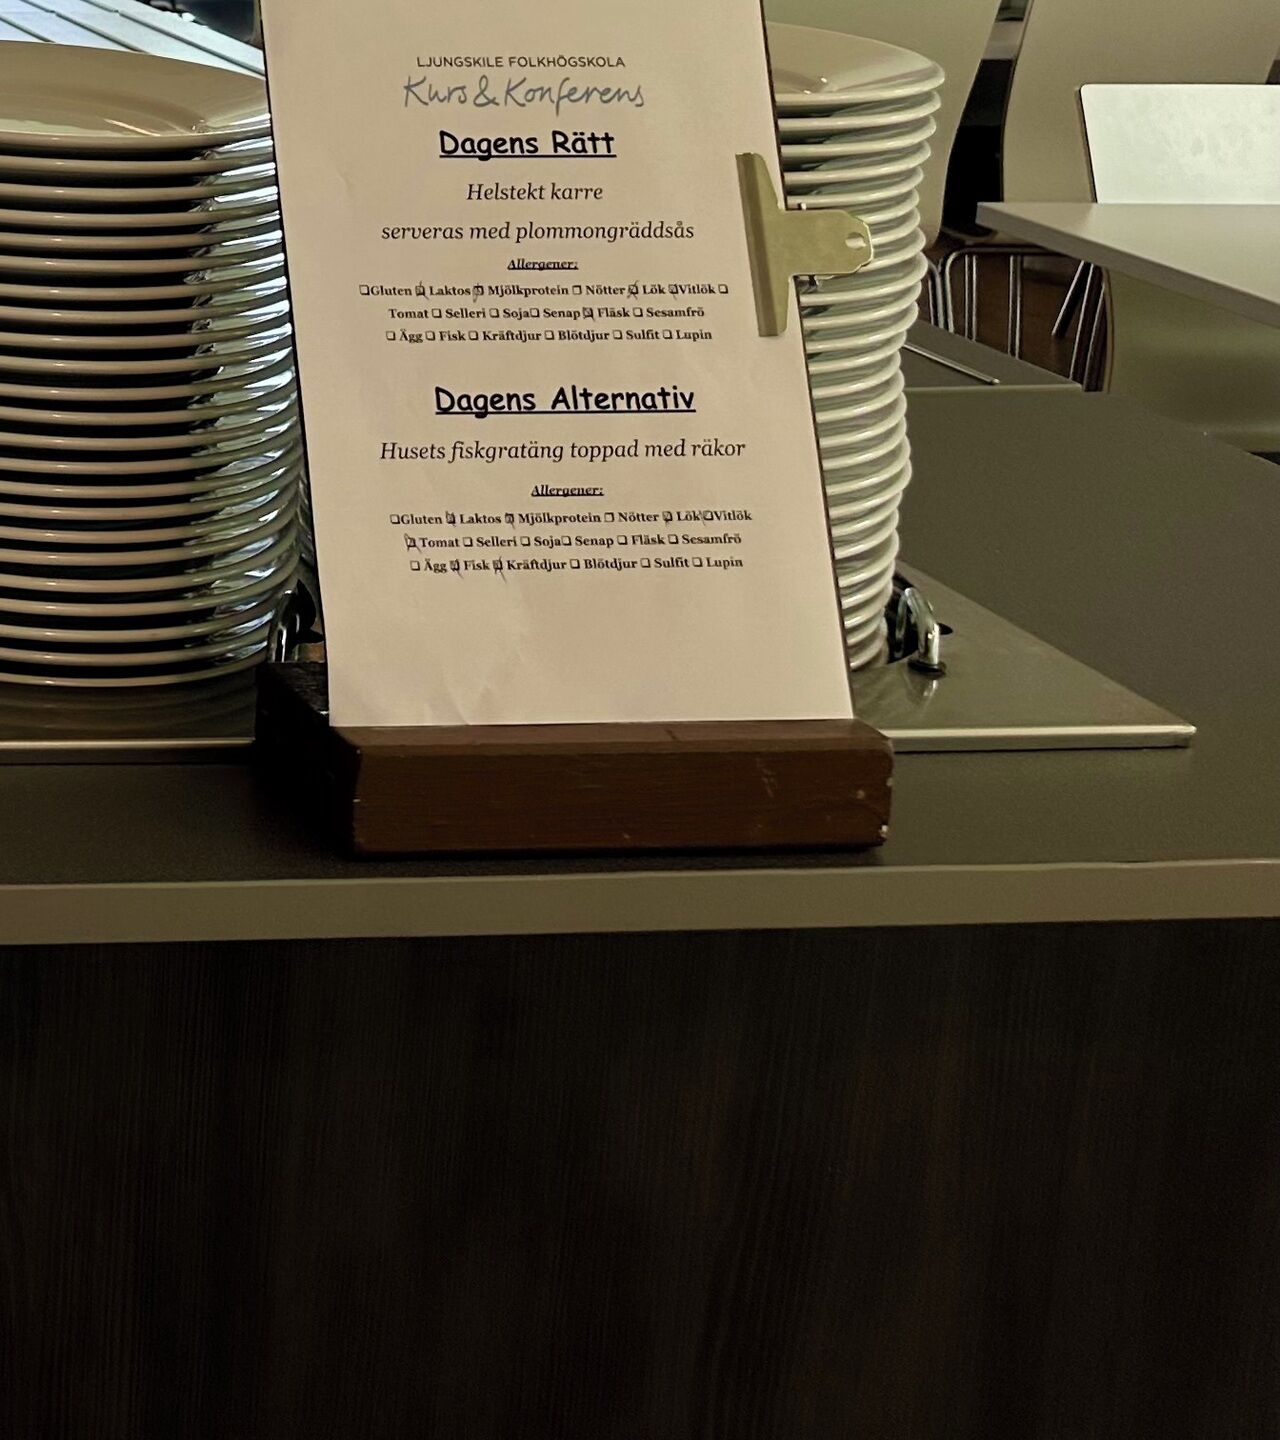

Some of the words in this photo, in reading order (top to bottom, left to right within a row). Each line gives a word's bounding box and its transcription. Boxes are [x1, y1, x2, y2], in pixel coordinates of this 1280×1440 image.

[416, 56, 504, 68] LJUNGSKILE
[508, 55, 626, 68] FOLKHÖGSKOLA
[439, 130, 539, 161] Dagens
[551, 130, 616, 158] Rätt
[466, 182, 545, 201] Helstekt
[550, 182, 604, 201] karre
[381, 223, 464, 240] serveras
[469, 221, 510, 240] med
[515, 220, 695, 243] plommongräddsås
[370, 285, 413, 296] Gluten
[429, 285, 471, 296] Laktos
[487, 284, 569, 298] Mjölkprotein
[585, 283, 626, 295] Nötter
[642, 283, 666, 295] Lök
[678, 283, 716, 295] Vitlök
[388, 308, 429, 319] Tomat
[445, 307, 486, 319] Selleri
[502, 307, 530, 320] Soja
[543, 308, 581, 320] Senap
[597, 307, 630, 318] Fläsk
[646, 306, 705, 318] Sesamfrö
[399, 328, 423, 343] Ägg
[439, 330, 466, 341] Fisk
[482, 329, 542, 343] Kräftdjur
[558, 329, 610, 343] Blötdjur
[625, 328, 660, 340] Sulfit
[675, 329, 713, 342] Lupin
[435, 385, 536, 419] Dagens
[550, 384, 696, 413] Alternativ
[380, 442, 446, 460] Husets
[448, 440, 564, 463] fiskgratäng
[570, 439, 639, 462] toppad
[644, 438, 686, 458] med
[691, 438, 746, 457] räkor
[401, 514, 443, 525] Gluten
[459, 513, 502, 524] Laktos
[518, 512, 602, 526] Mjölkprotein
[617, 511, 660, 522] Nötter
[677, 511, 700, 522] Lök
[713, 510, 753, 522] Vitlök
[418, 537, 460, 548] Tomat
[476, 536, 518, 547] Selleri
[534, 535, 562, 549] Soja
[575, 535, 614, 549] Senap
[631, 534, 665, 545] Fläsk
[681, 533, 742, 545] Sesamfrö
[424, 558, 447, 572] Ägg
[464, 559, 490, 571] Fisk
[506, 558, 568, 572] Kräftdjur
[584, 558, 638, 571] Blötdjur
[654, 557, 690, 569] Sulfit
[704, 556, 743, 570] Lupin
